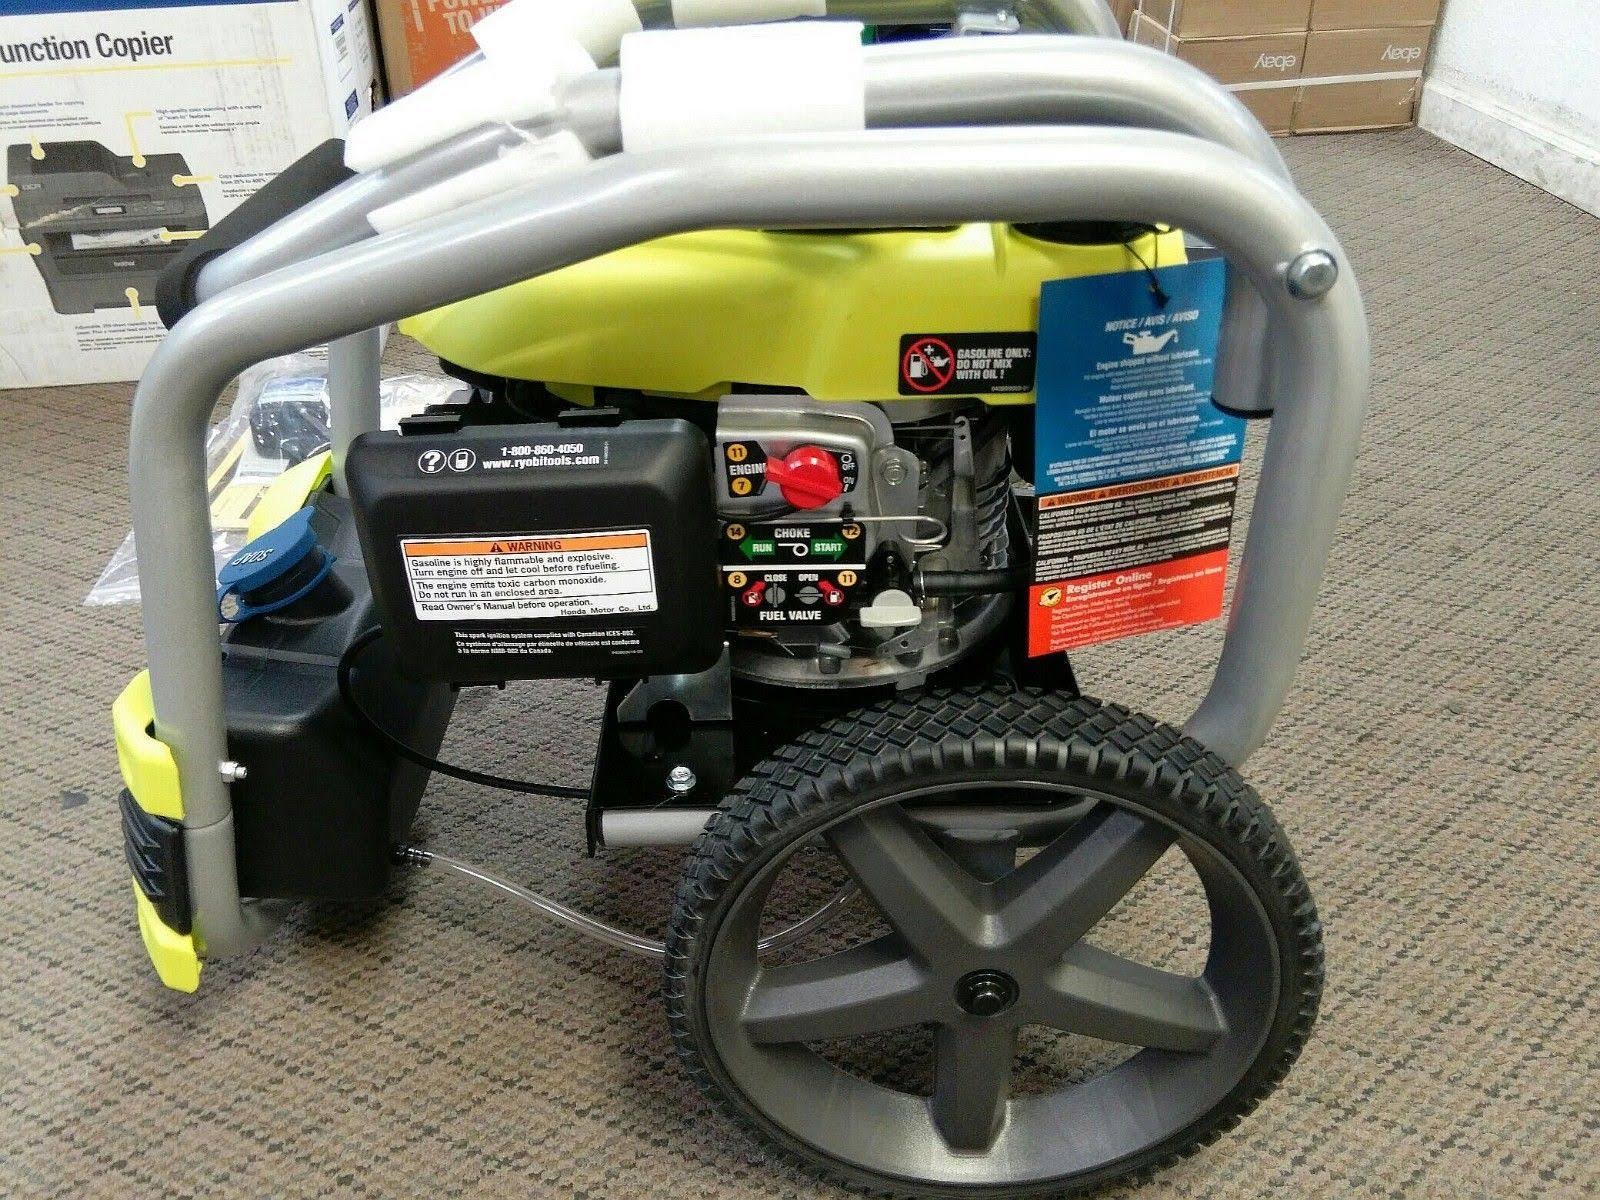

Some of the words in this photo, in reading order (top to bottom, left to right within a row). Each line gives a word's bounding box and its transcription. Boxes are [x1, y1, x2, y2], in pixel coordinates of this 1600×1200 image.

[96, 31, 173, 61] Copier
[1381, 45, 1421, 62] ebay
[1254, 53, 1296, 71] ebay
[957, 348, 1003, 359] GASOLINE
[1005, 348, 1032, 358] ONLY:
[956, 360, 970, 369] DO
[972, 360, 991, 369] NOT
[993, 359, 1012, 368] MIX
[956, 370, 980, 379] WITH
[983, 369, 998, 379] OIL
[501, 443, 584, 456] 1-800-860-4050
[732, 448, 743, 457] 11
[483, 454, 600, 469] www.ryobitools.com
[738, 481, 745, 490] 7
[843, 476, 855, 485] ON
[729, 527, 741, 537] 14
[774, 528, 811, 538] CHOKE
[845, 526, 858, 536] 12
[507, 541, 562, 552] WARNING
[752, 543, 772, 552] RUN
[814, 543, 843, 551] START
[231, 548, 274, 566] SOAP
[412, 559, 451, 567] Gasoline
[464, 558, 491, 567] highly
[495, 556, 544, 565] flammable
[567, 553, 614, 562] explosive.
[413, 568, 434, 576] Turn
[437, 568, 467, 577] engine
[471, 567, 483, 575] off
[506, 566, 518, 574] let
[521, 565, 540, 573] cool
[543, 564, 576, 573] before
[576, 562, 620, 571] refueling.
[437, 582, 467, 590] engine
[498, 580, 520, 588] toxic
[524, 578, 556, 587] carbon
[559, 576, 607, 585] monoxide.
[734, 575, 741, 584] 8
[843, 573, 853, 583] 11
[1066, 578, 1113, 594] Register
[1116, 572, 1152, 586] Online
[495, 588, 535, 597] enclosed
[539, 588, 562, 596] area.
[422, 603, 444, 611] Read
[447, 603, 480, 611] Owner's
[483, 602, 515, 610] Manual
[518, 600, 546, 609] before
[549, 599, 593, 608] operation.
[760, 611, 787, 620] FUEL
[789, 610, 822, 620] VALVE
[487, 632, 510, 640] ignition
[534, 631, 561, 639] complies
